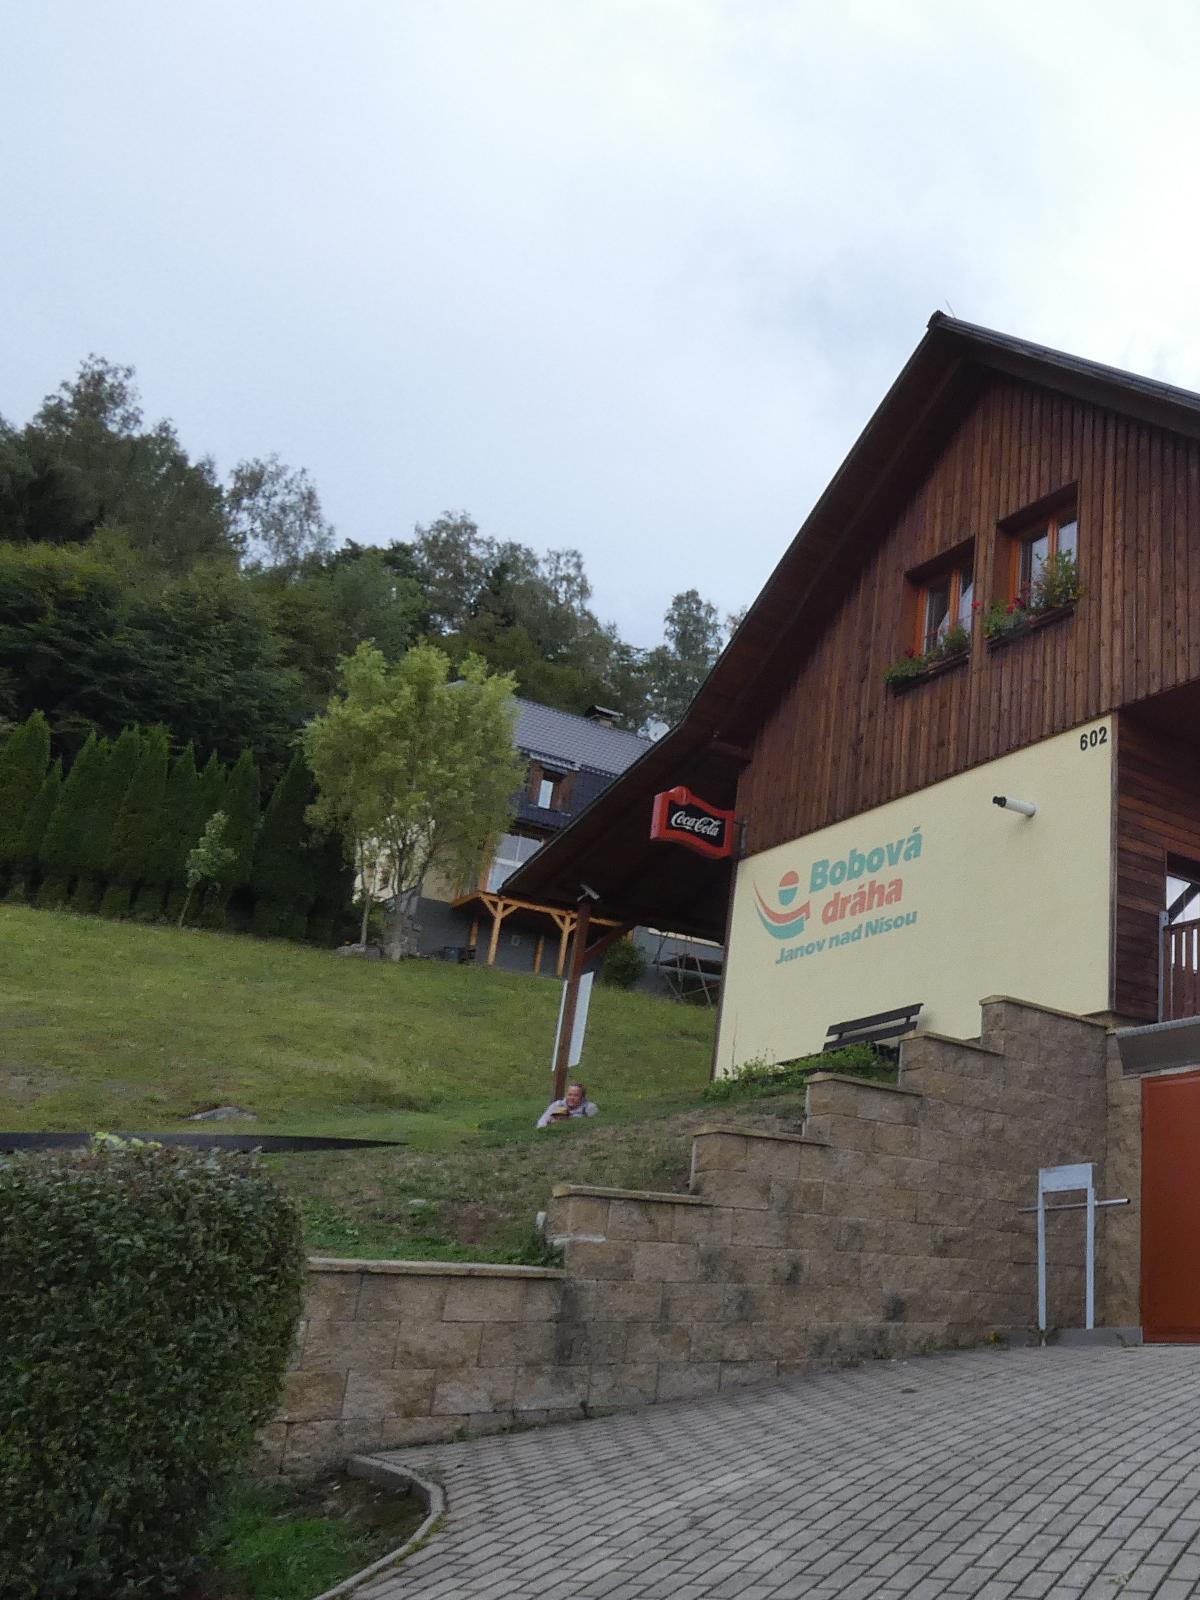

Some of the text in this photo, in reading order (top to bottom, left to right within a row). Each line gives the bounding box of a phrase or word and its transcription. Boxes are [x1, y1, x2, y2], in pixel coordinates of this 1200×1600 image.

[1080, 726, 1107, 751] 602
[809, 825, 923, 893] Bobová
[822, 878, 903, 925] dráha
[775, 911, 918, 965] Janov nad Nisou
